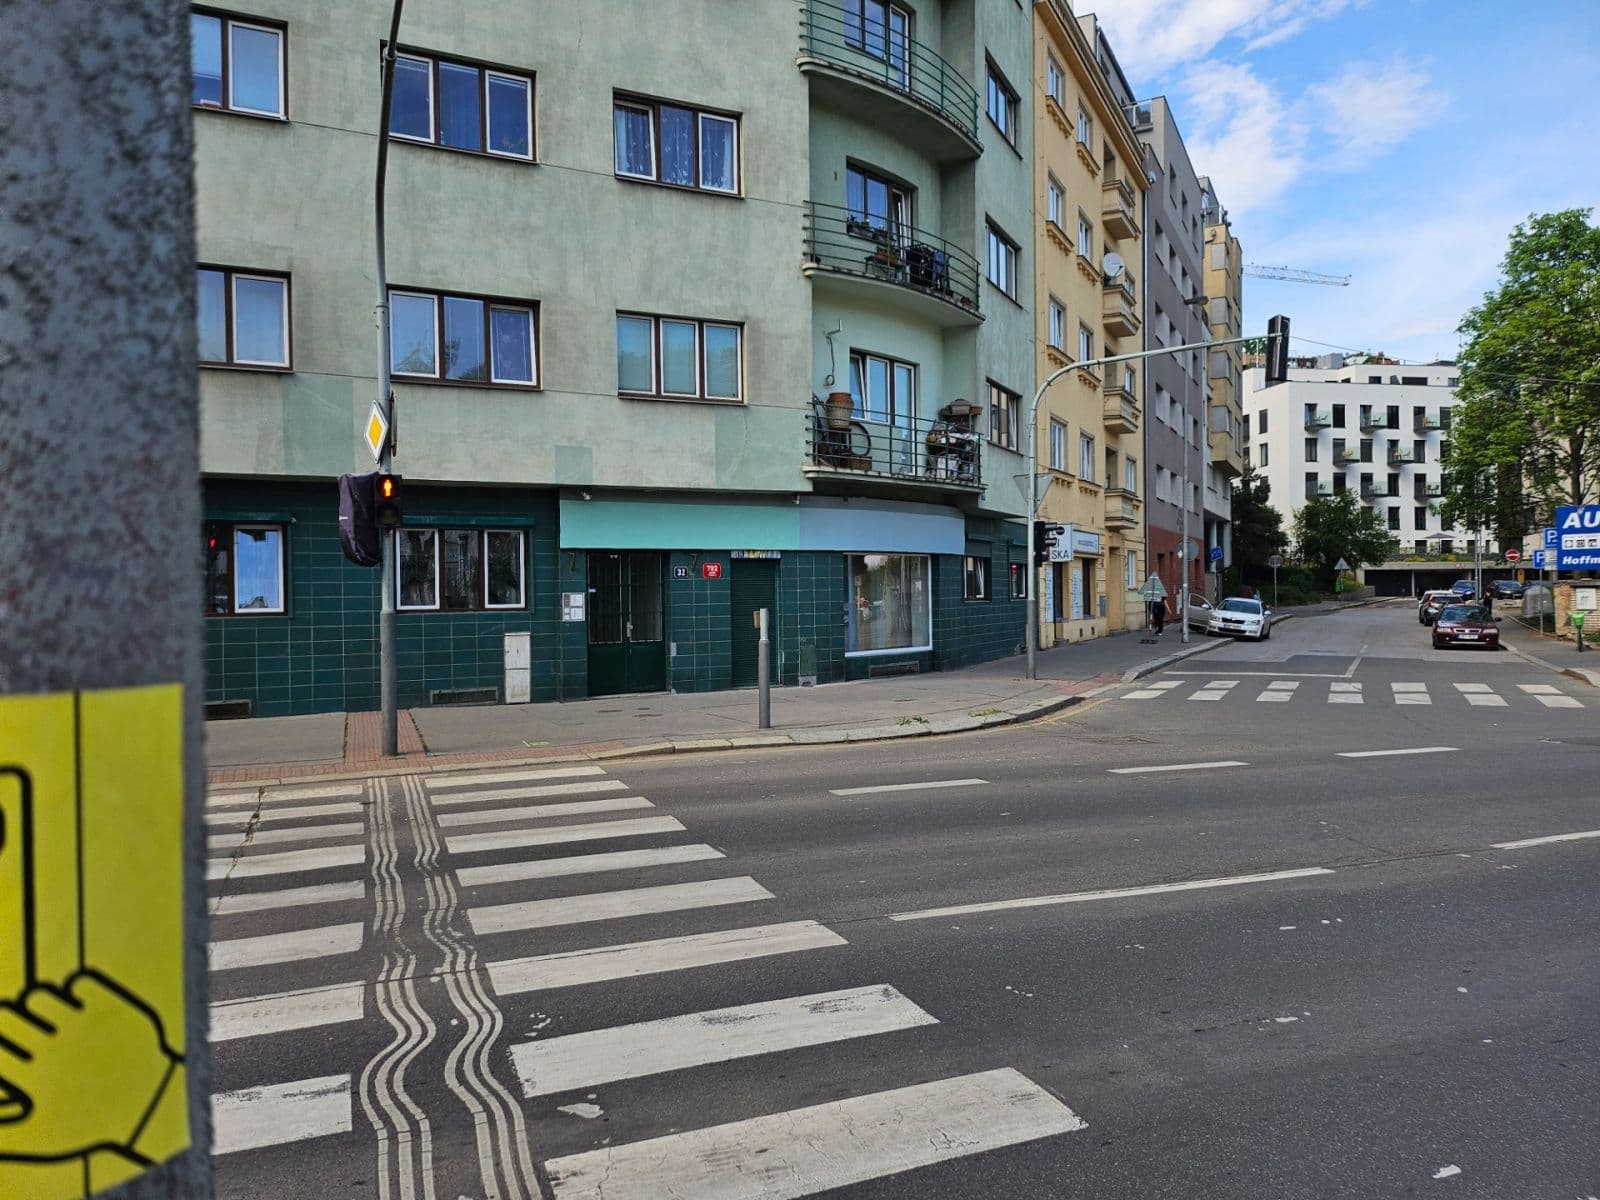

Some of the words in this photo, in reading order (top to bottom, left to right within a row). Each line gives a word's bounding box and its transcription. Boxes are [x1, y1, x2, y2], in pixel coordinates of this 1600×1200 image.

[1547, 530, 1557, 543] P
[1051, 549, 1070, 560] SKA
[1536, 551, 1545, 563] P
